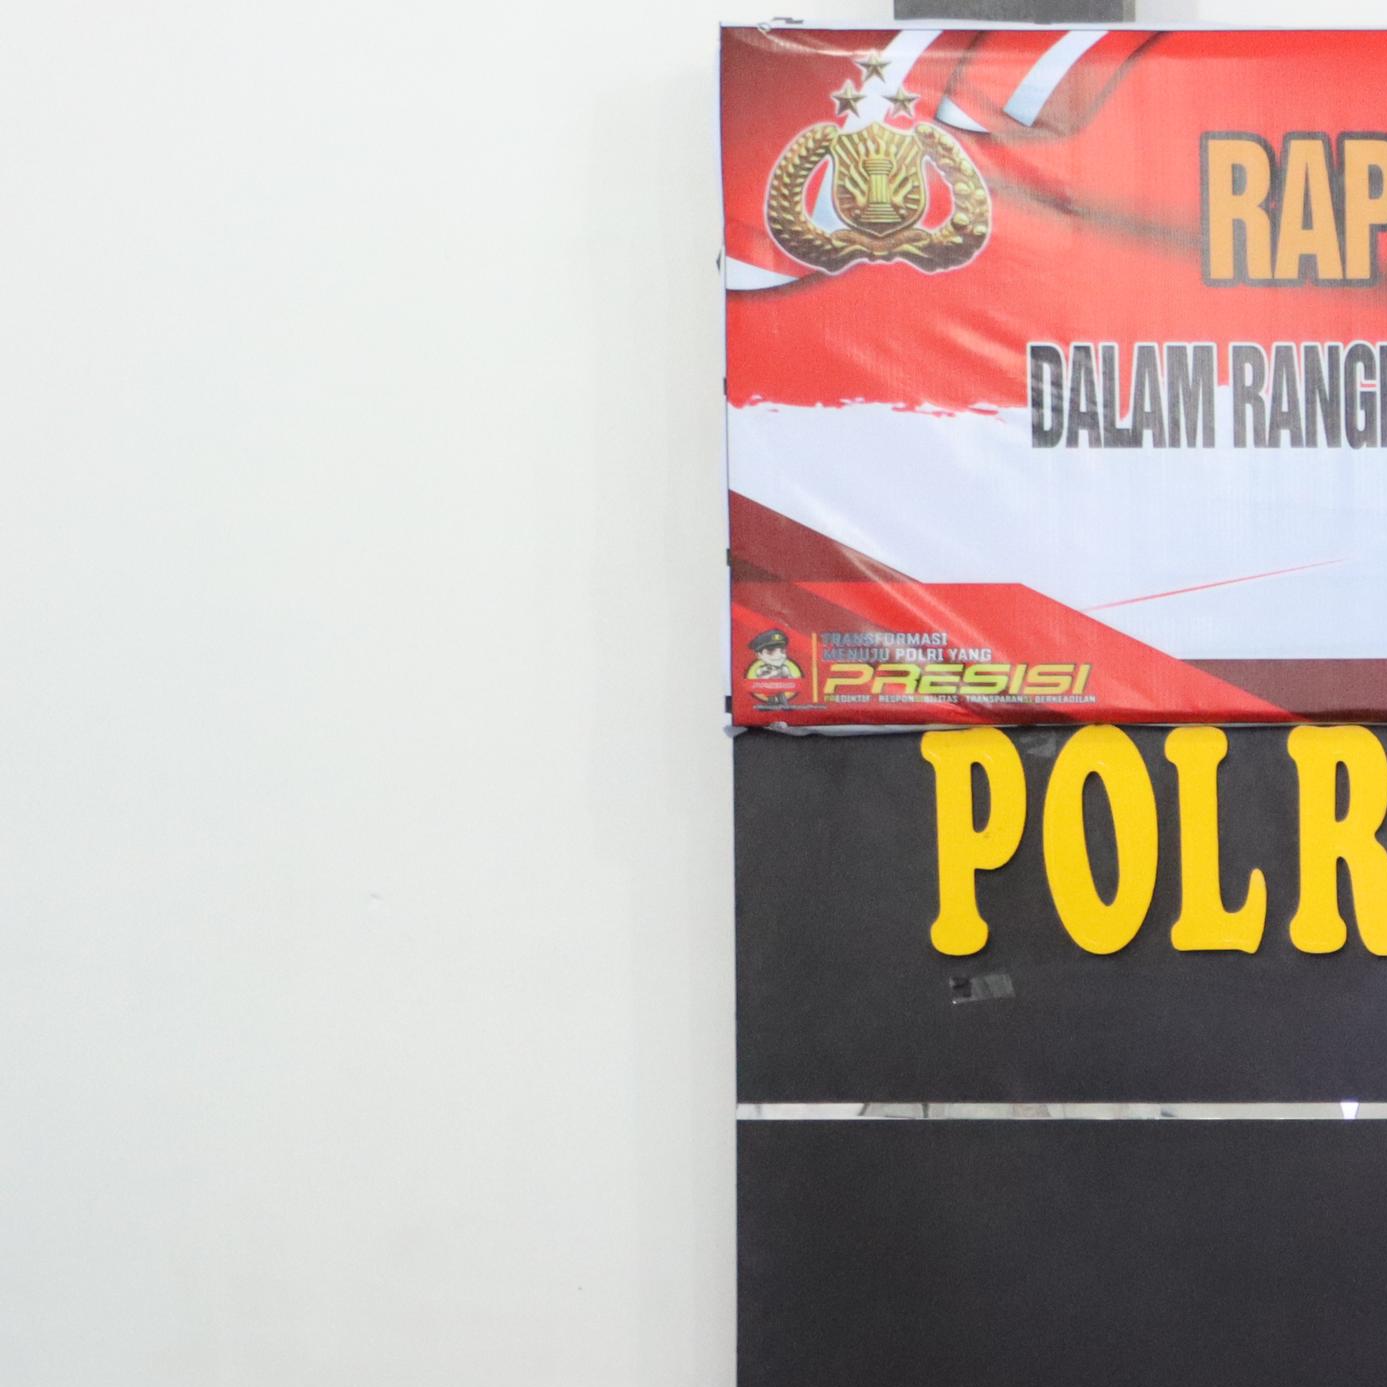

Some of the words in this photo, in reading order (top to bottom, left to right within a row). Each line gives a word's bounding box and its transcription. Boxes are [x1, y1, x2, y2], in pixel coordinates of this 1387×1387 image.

[1029, 342, 1217, 449] DALAM
[821, 632, 949, 647] TRANSFORMASI
[895, 647, 945, 661] POLRI
[949, 647, 993, 661] YANG
[824, 663, 1092, 695] PRESISI
